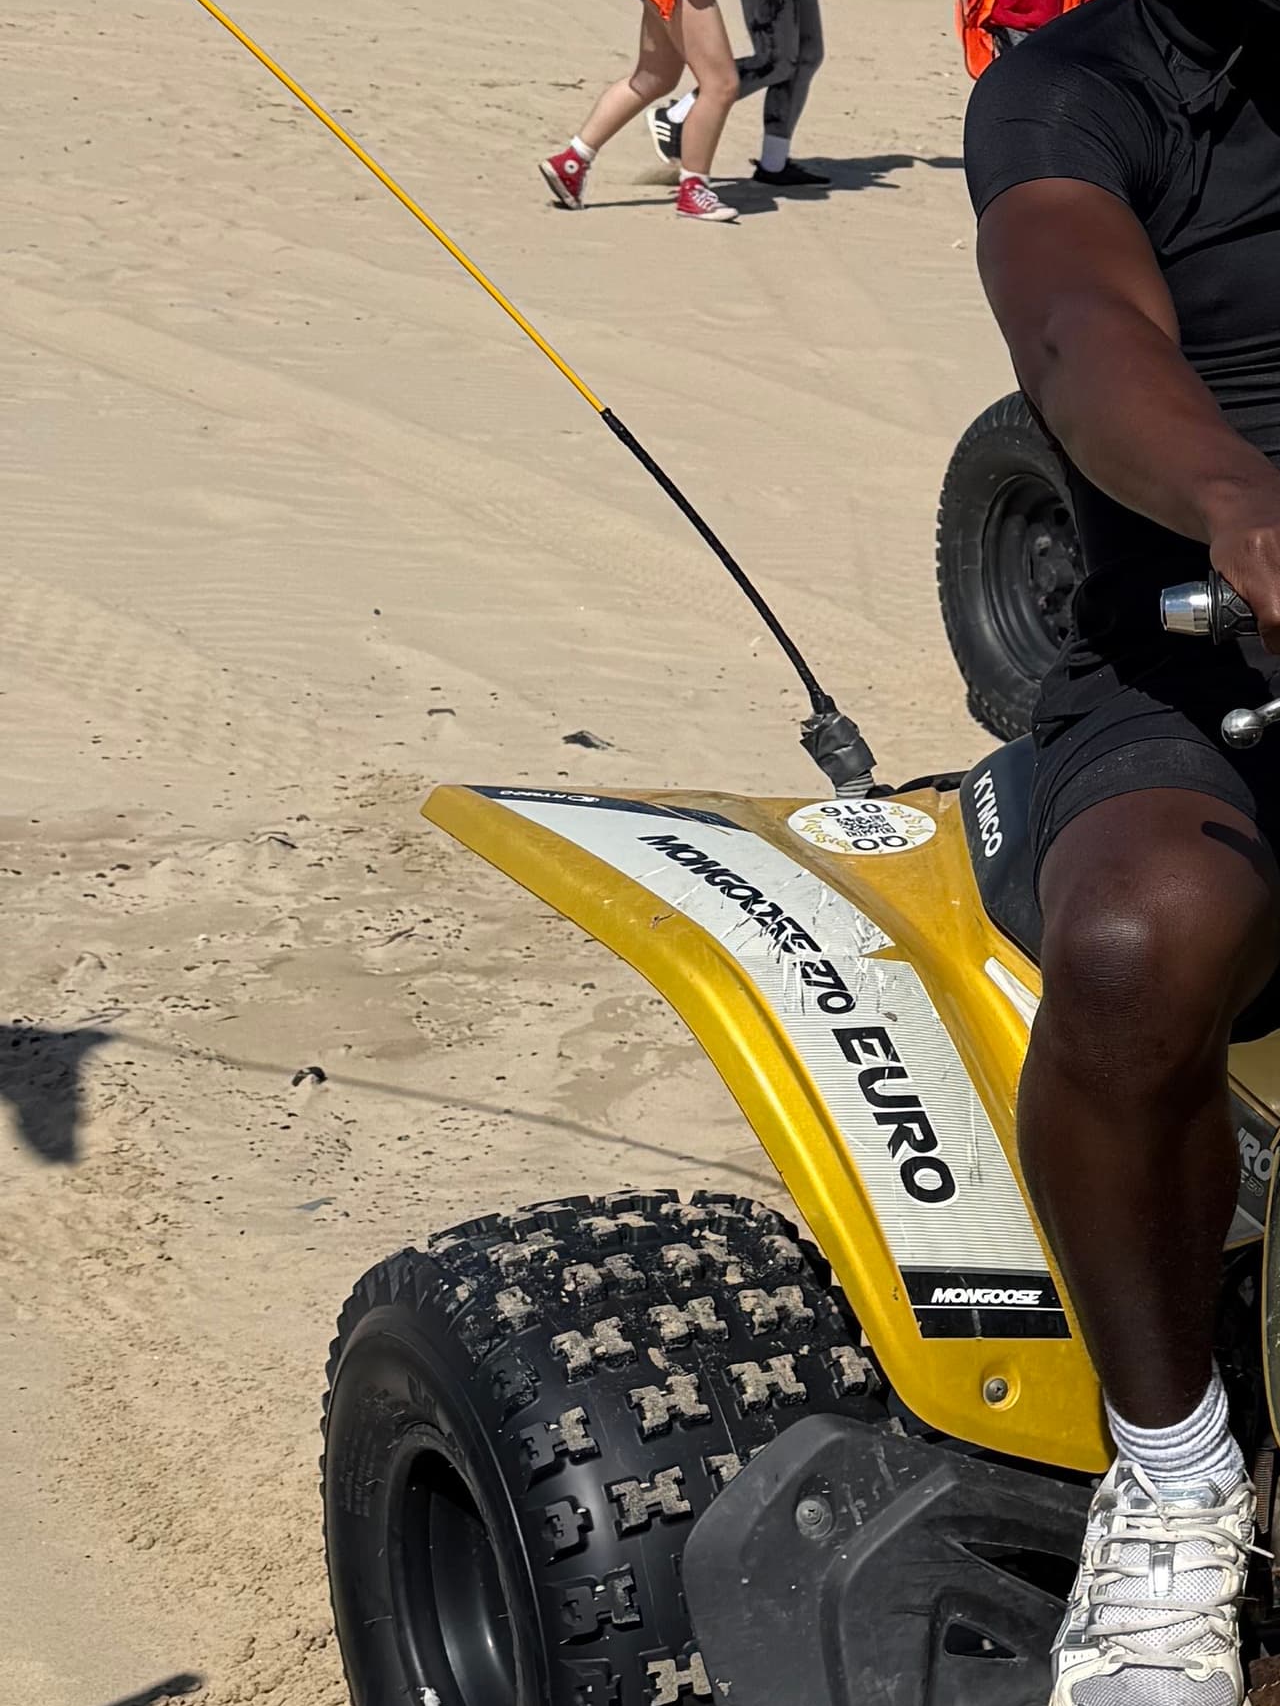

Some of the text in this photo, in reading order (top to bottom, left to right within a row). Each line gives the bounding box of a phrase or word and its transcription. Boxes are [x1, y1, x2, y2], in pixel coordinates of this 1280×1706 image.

[819, 802, 883, 817] 016
[973, 769, 1003, 858] KYMCO
[636, 834, 957, 1204] MONGOOSE 270 EURO
[930, 1287, 1043, 1305] MONGOOSE
